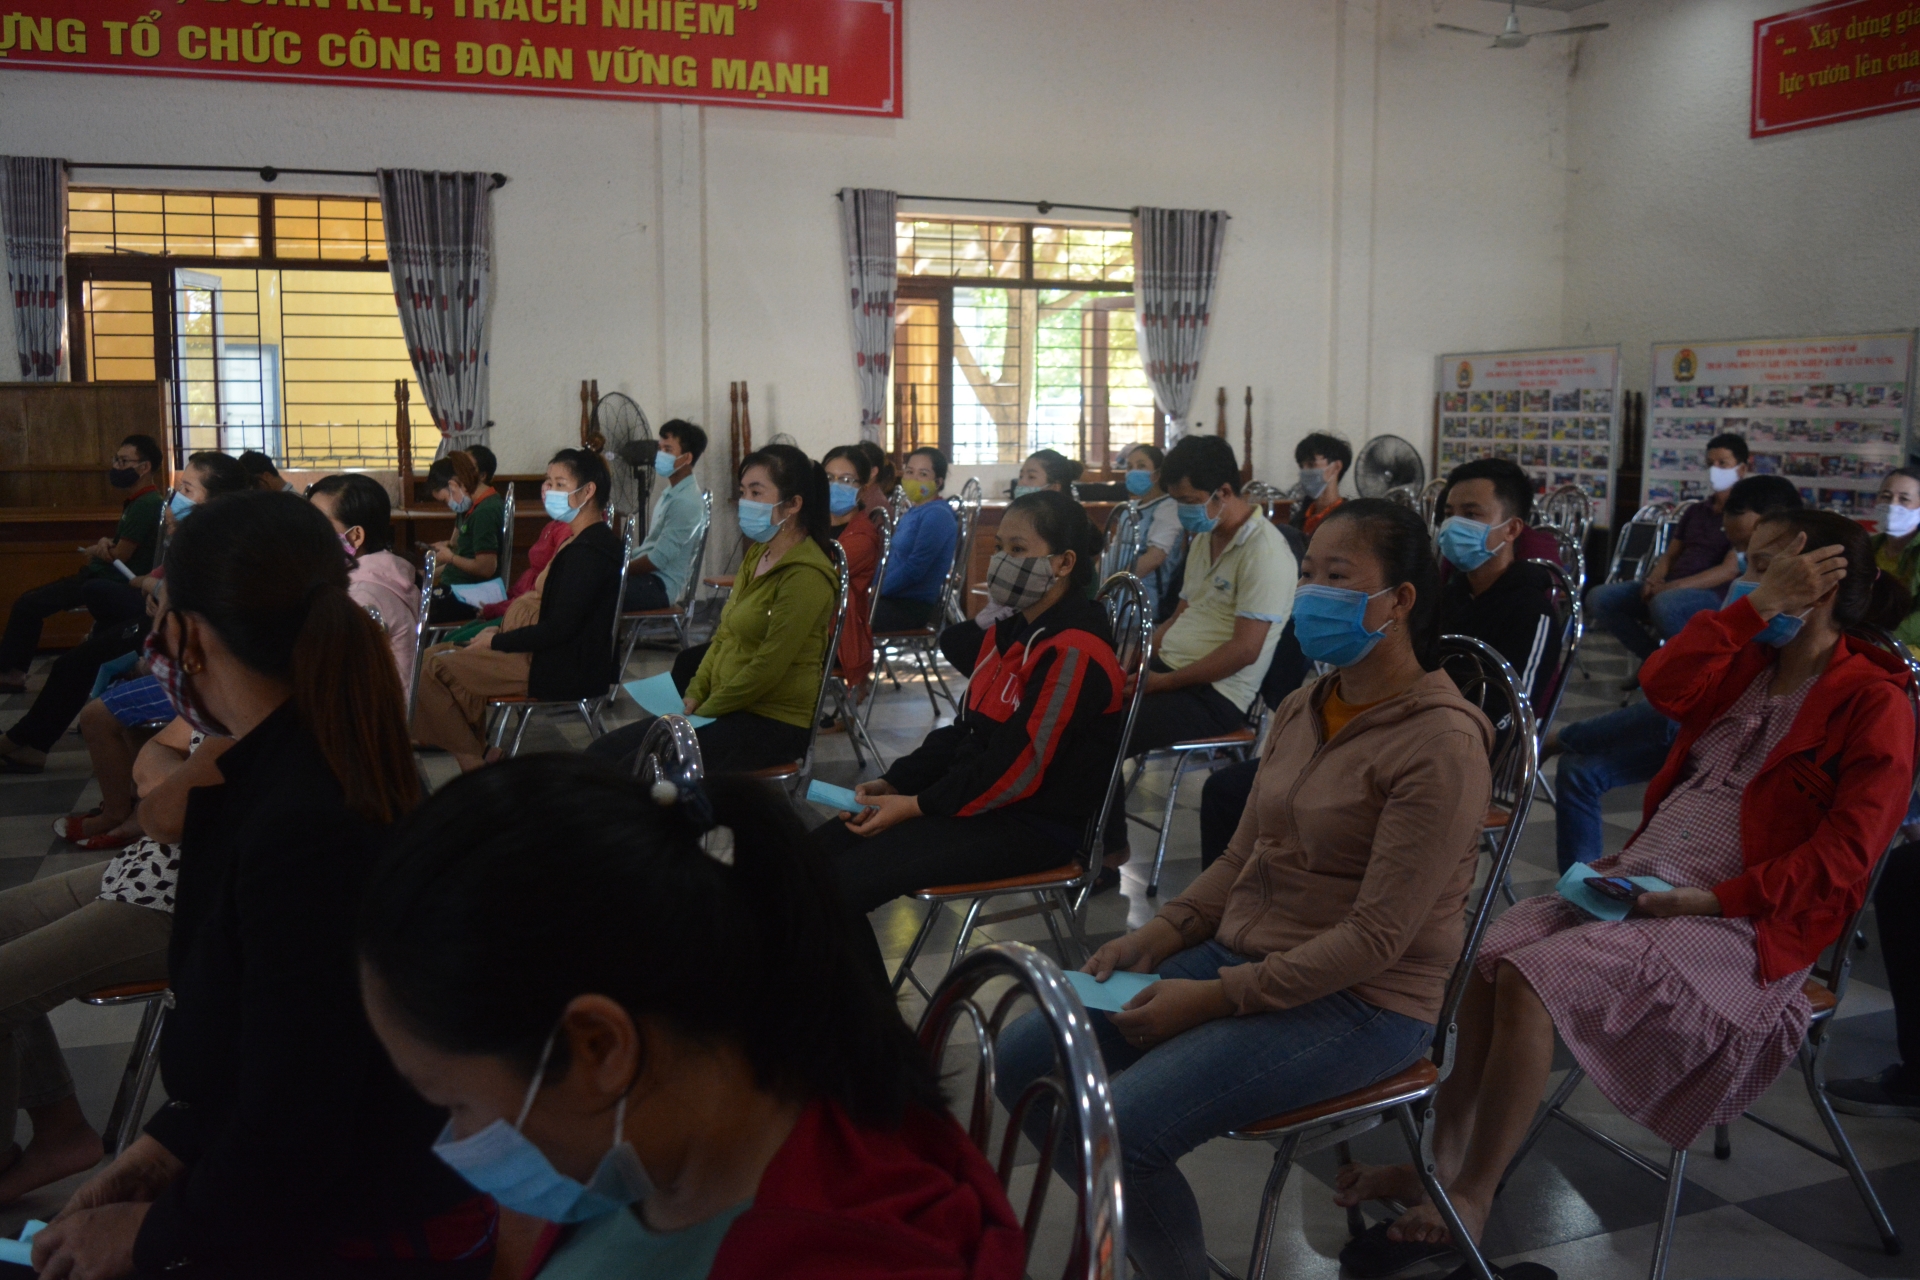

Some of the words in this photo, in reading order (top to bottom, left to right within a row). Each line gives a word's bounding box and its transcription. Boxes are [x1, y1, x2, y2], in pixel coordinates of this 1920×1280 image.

[1846, 15, 1892, 43] dựng
[102, 10, 162, 58] TỔ
[178, 22, 303, 65] CHỨC
[318, 28, 441, 73] CÔNG
[455, 38, 573, 80] ĐOÀN
[587, 45, 699, 87] VỮNG
[712, 57, 829, 99] MẠNH
[1778, 71, 1805, 100] lực
[1855, 53, 1882, 78] lên
